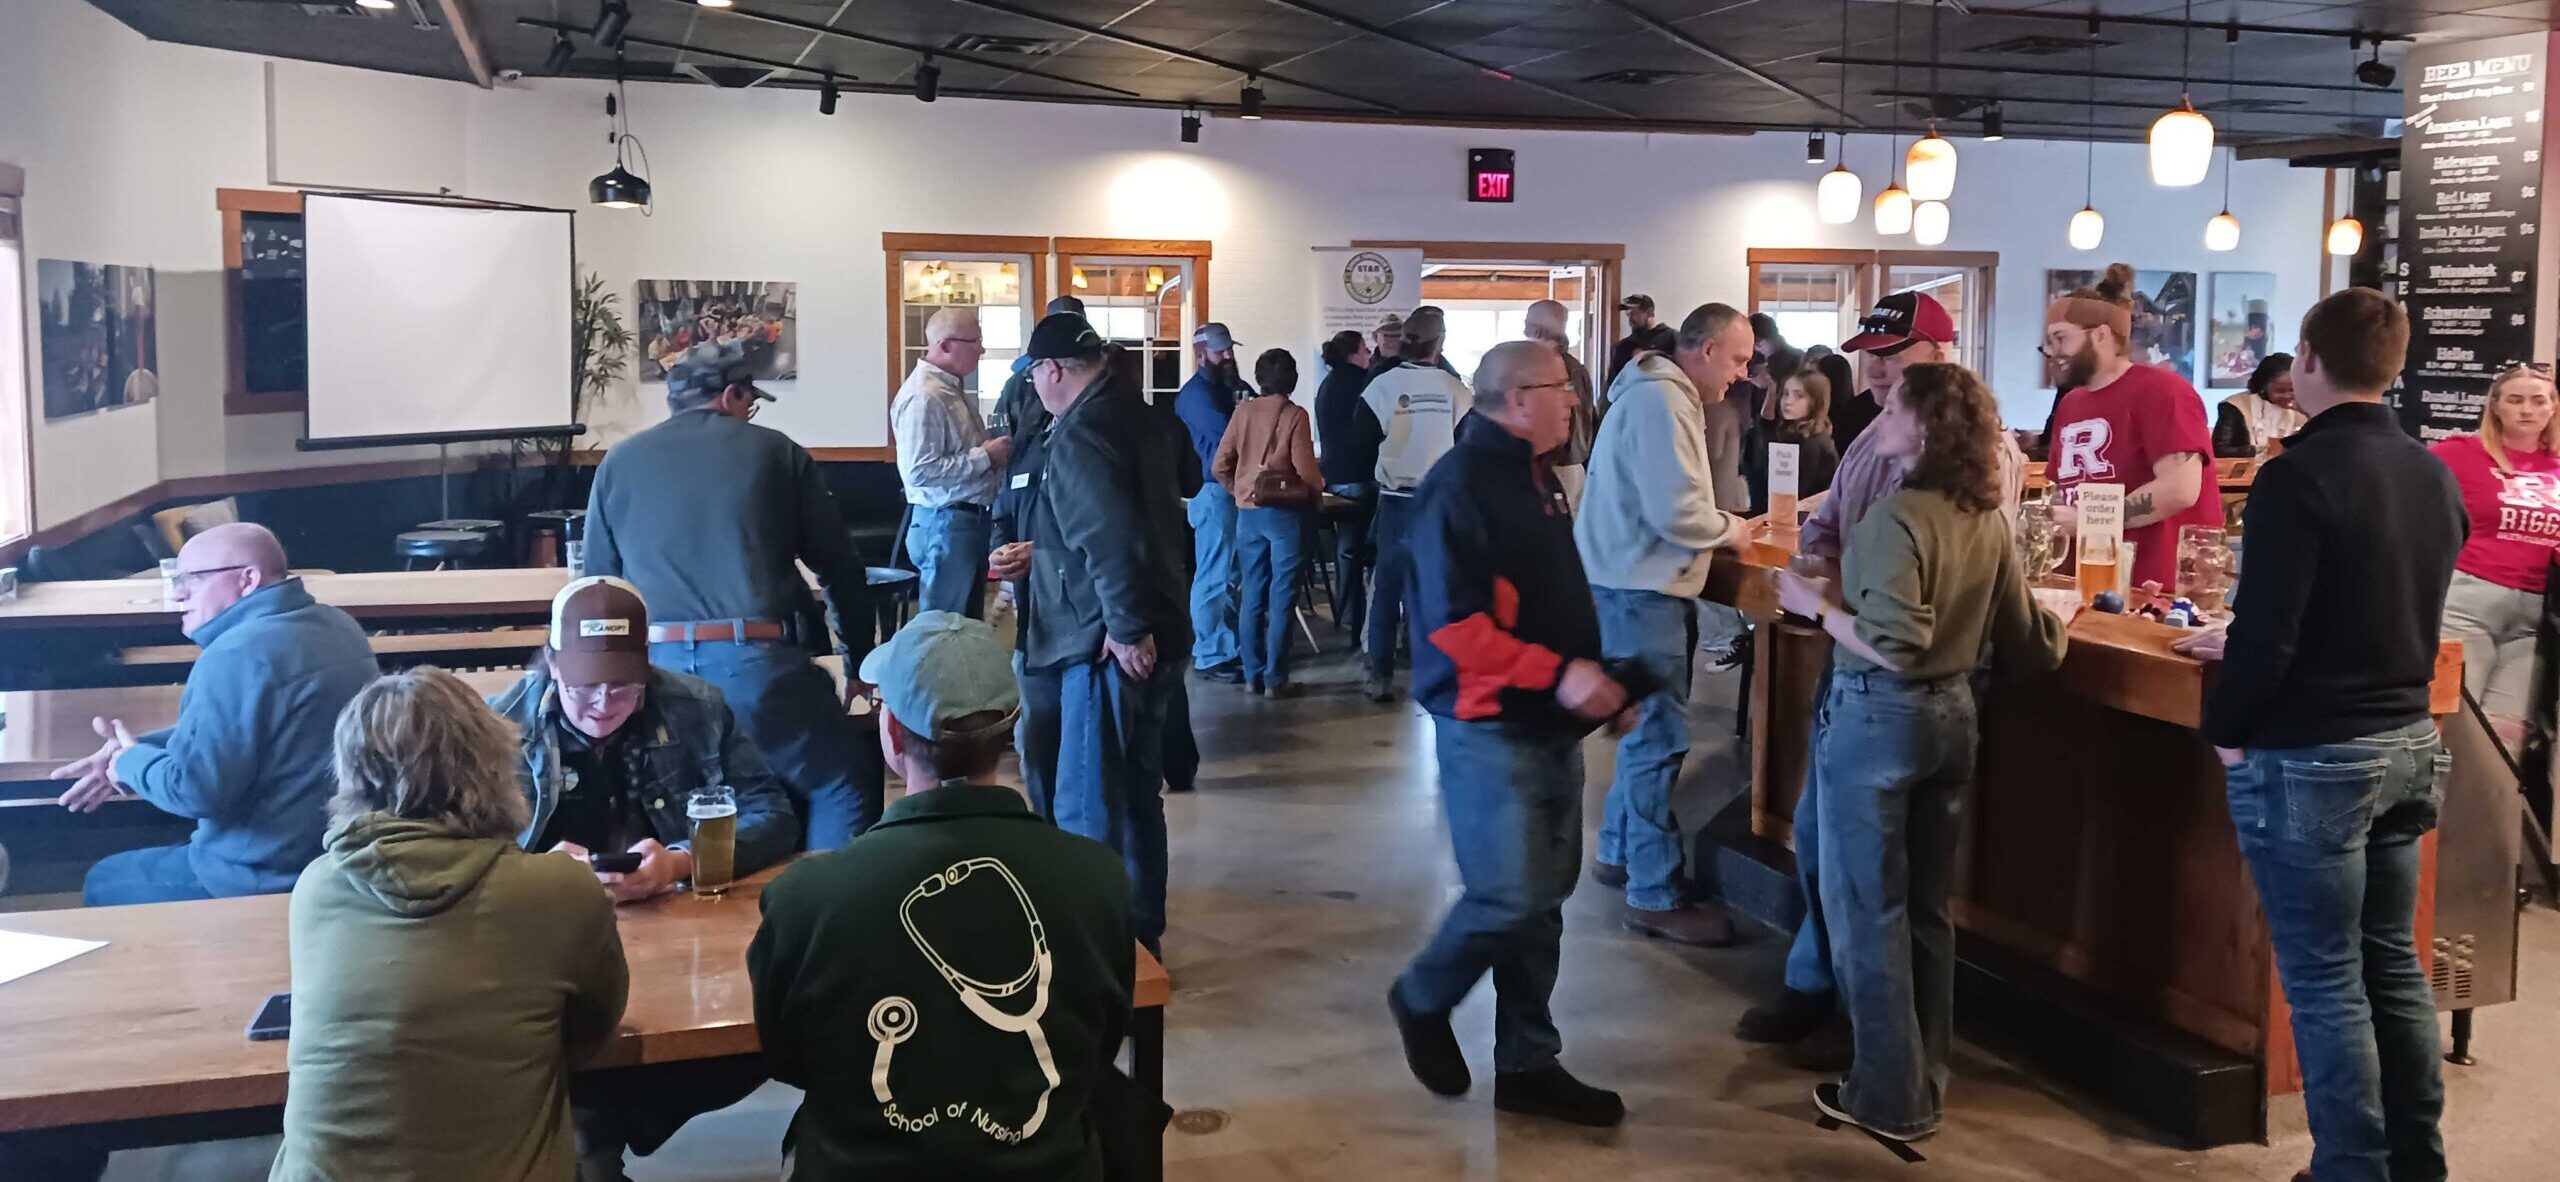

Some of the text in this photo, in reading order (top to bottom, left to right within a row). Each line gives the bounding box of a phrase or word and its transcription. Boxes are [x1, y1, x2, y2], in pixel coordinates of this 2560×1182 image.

[2424, 54, 2532, 82] BEER MENU
[2425, 116, 2513, 134] American Lager
[1478, 173, 1510, 198] EXIT
[2436, 191, 2492, 205] Red Lager
[2419, 225, 2507, 239] India Pale Lager
[1357, 264, 1381, 272] STAR
[2437, 347, 2474, 361] Helles
[2057, 417, 2116, 485] R
[2083, 491, 2119, 501] Please
[2086, 504, 2115, 514] order
[2086, 515, 2115, 525] here!
[2498, 507, 2560, 538] RIGG
[883, 1101, 1022, 1146] School of Nursing
